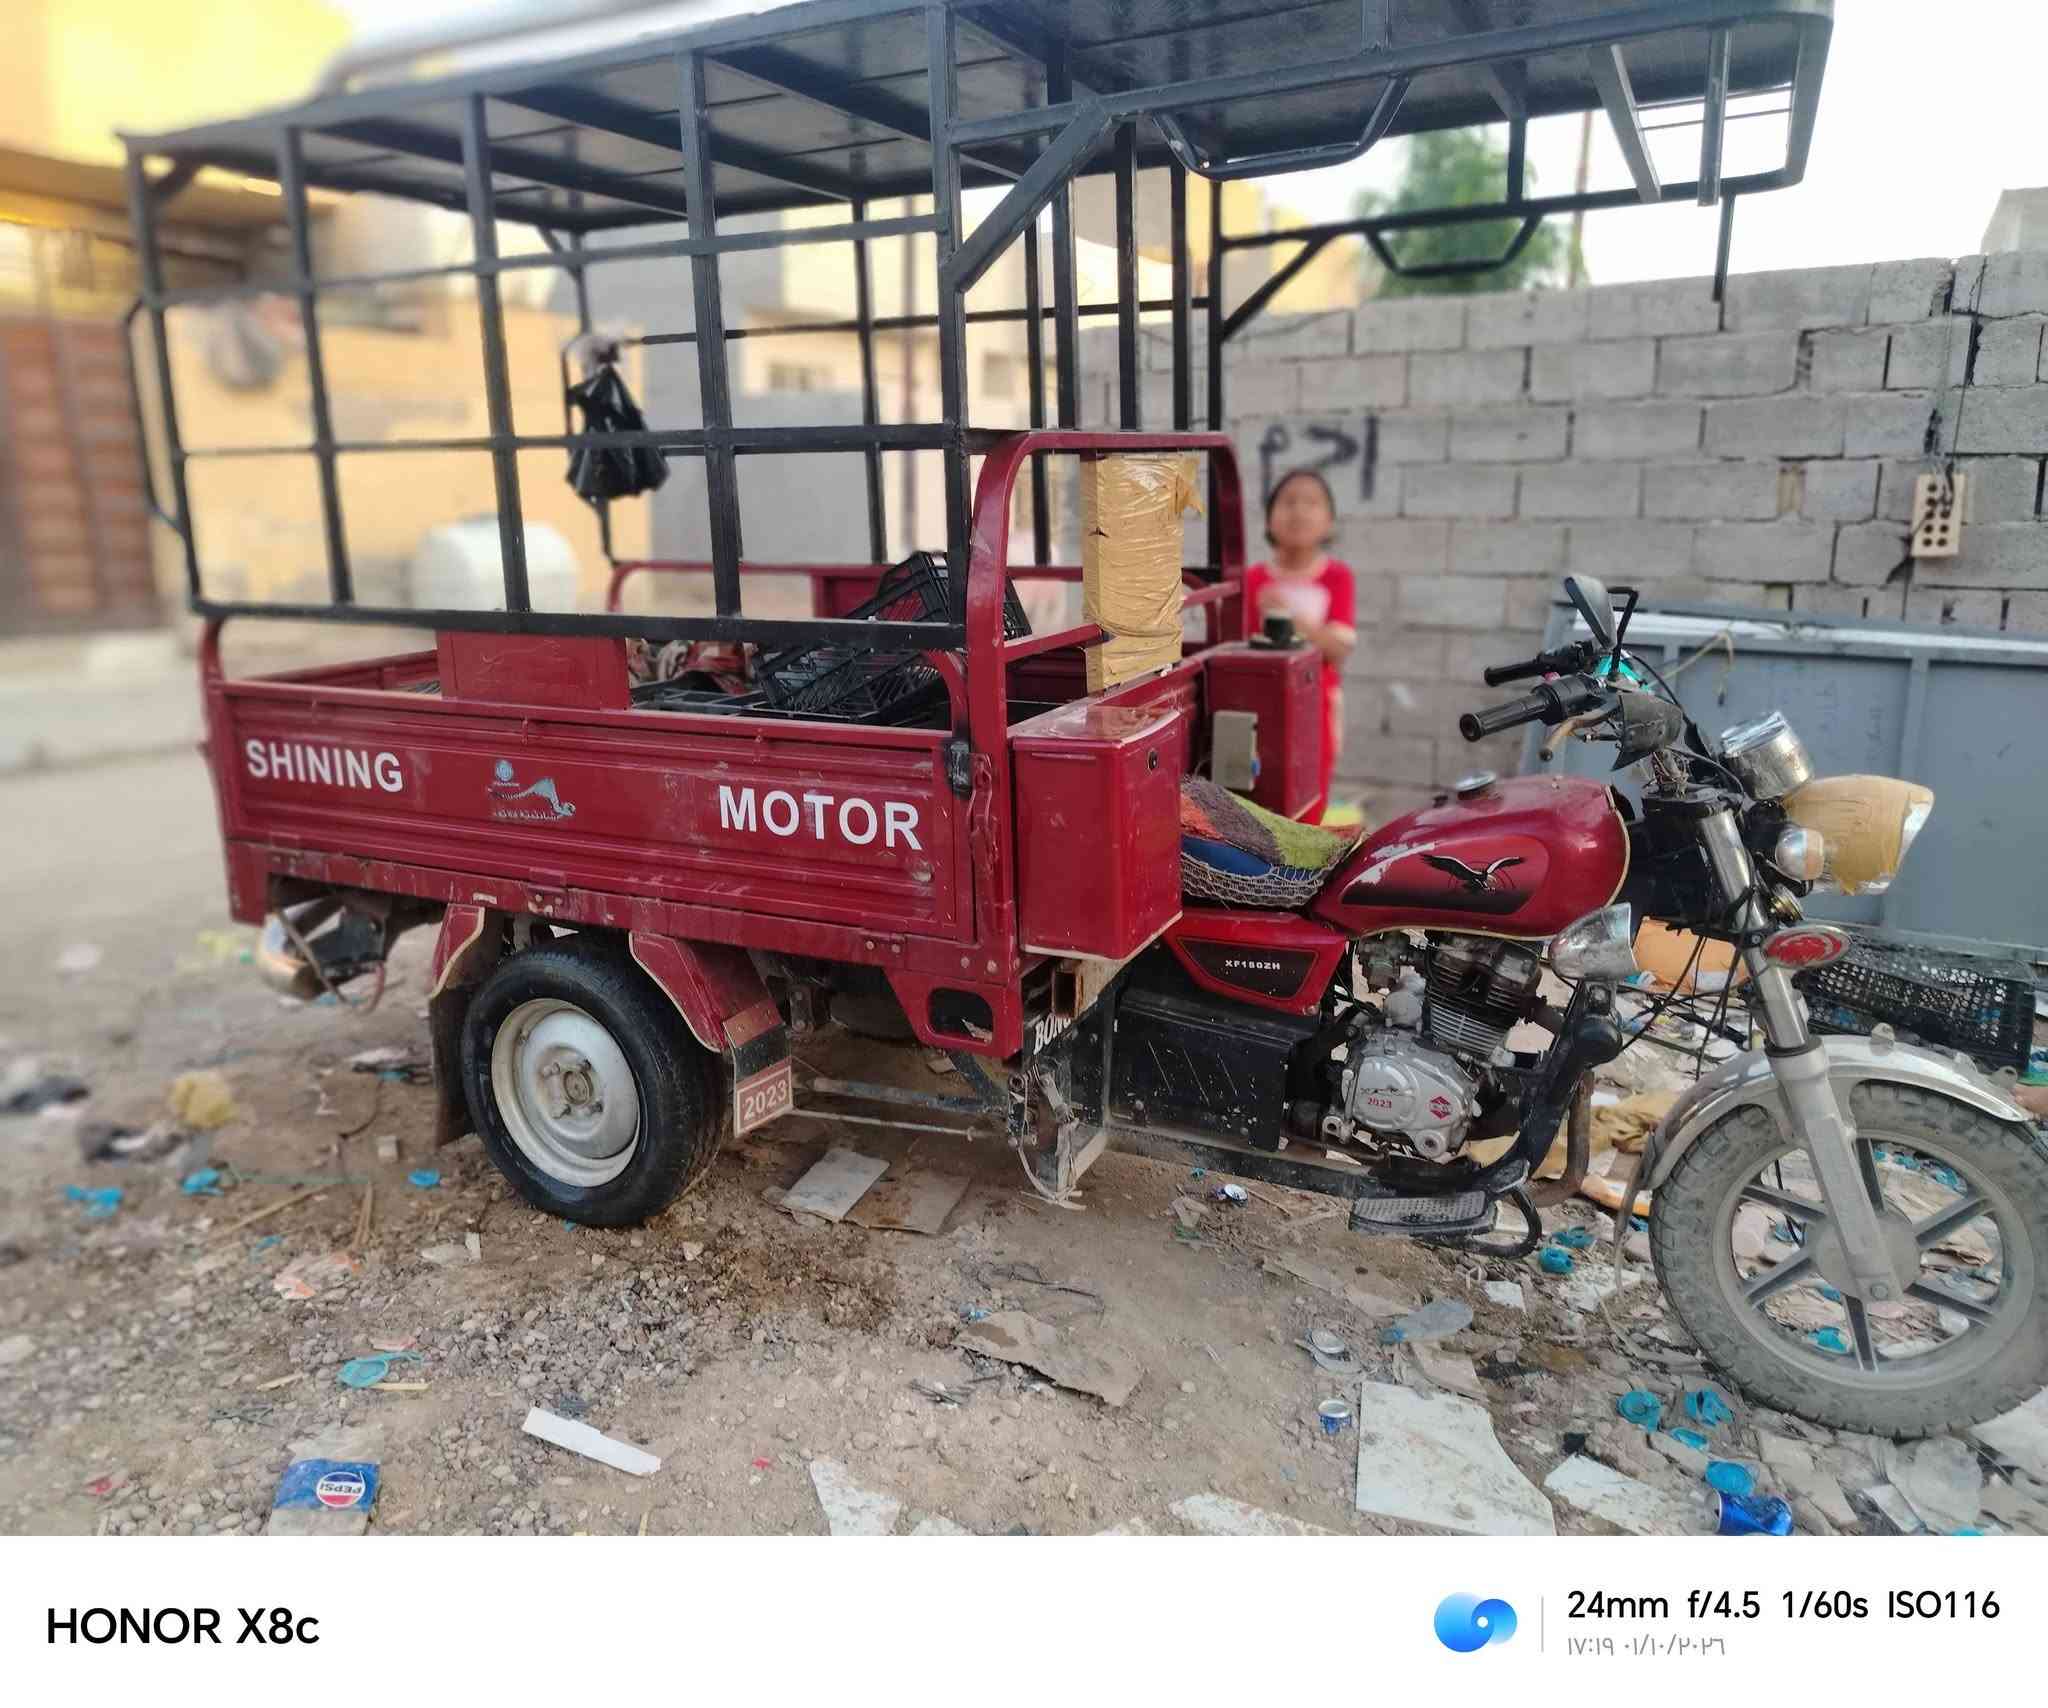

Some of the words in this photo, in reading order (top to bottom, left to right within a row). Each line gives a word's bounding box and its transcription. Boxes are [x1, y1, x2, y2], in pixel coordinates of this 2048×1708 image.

[247, 740, 403, 793] SHINING
[719, 784, 923, 852] MOTOR
[743, 1079, 787, 1121] 2023
[319, 1483, 363, 1494] PEPSI
